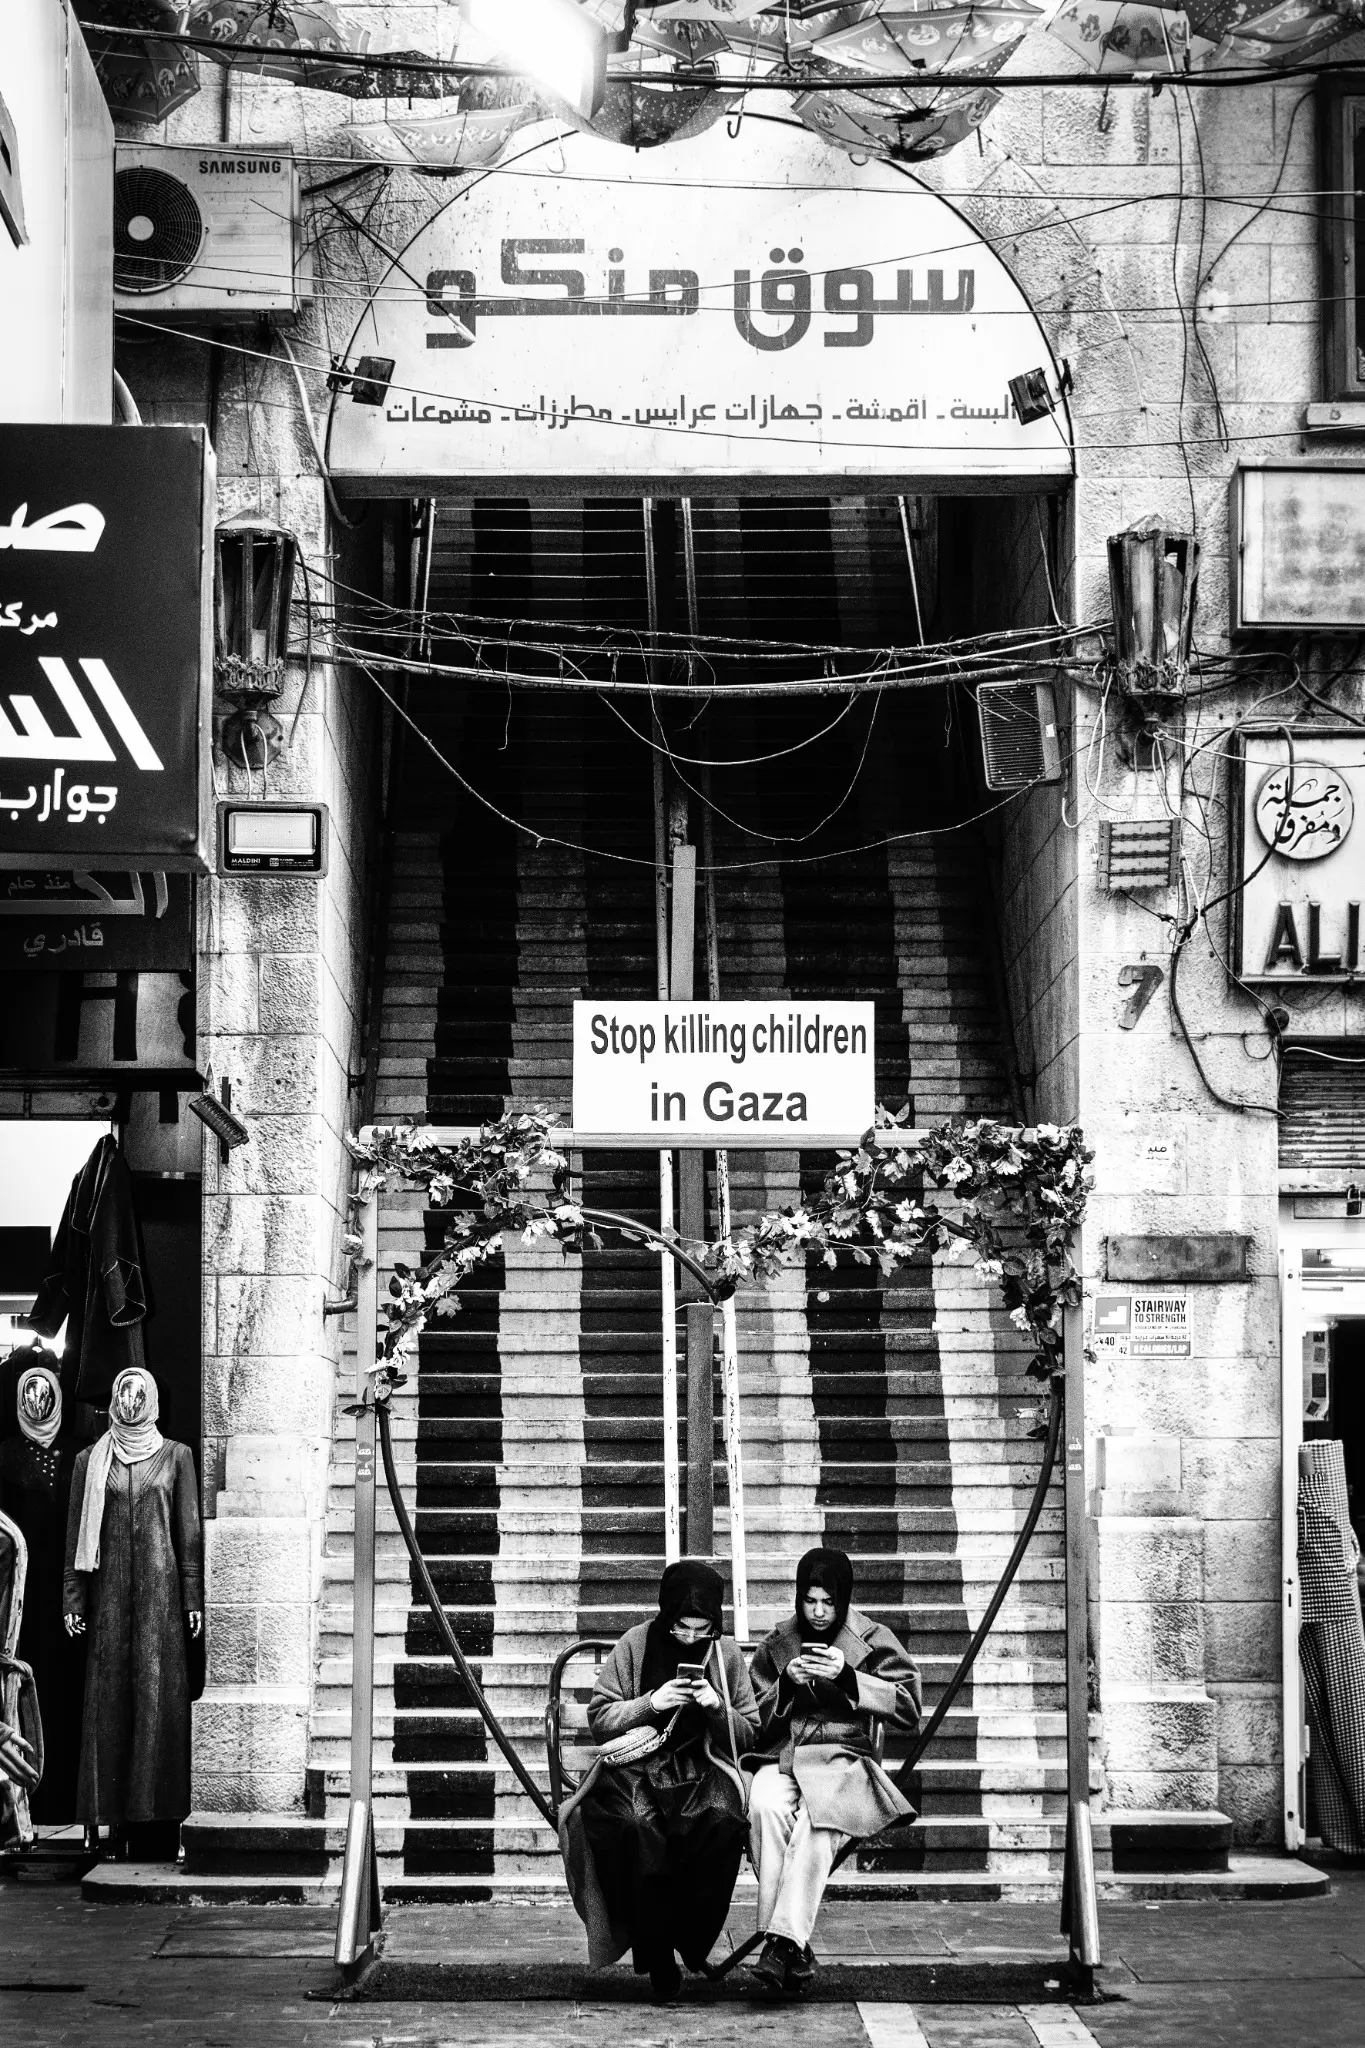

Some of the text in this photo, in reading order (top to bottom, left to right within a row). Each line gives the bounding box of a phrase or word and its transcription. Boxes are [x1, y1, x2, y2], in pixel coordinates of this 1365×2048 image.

[199, 160, 281, 174] SAMSUNG
[426, 238, 974, 351] سوق منكو
[386, 396, 491, 424] مشمعات
[515, 395, 611, 429] مطرزات
[635, 394, 716, 430] عرايس
[726, 394, 822, 428] جهازات
[0, 602, 58, 635] مرك
[24, 921, 104, 957] قادري
[1118, 965, 1164, 1030] 7
[591, 1014, 866, 1063] Stop killing children
[652, 1081, 807, 1121] in Gaza
[1135, 1300, 1186, 1312] STAIRWAY
[1135, 1313, 1186, 1322] TO STRENGTH
[1104, 1336, 1115, 1346] 40
